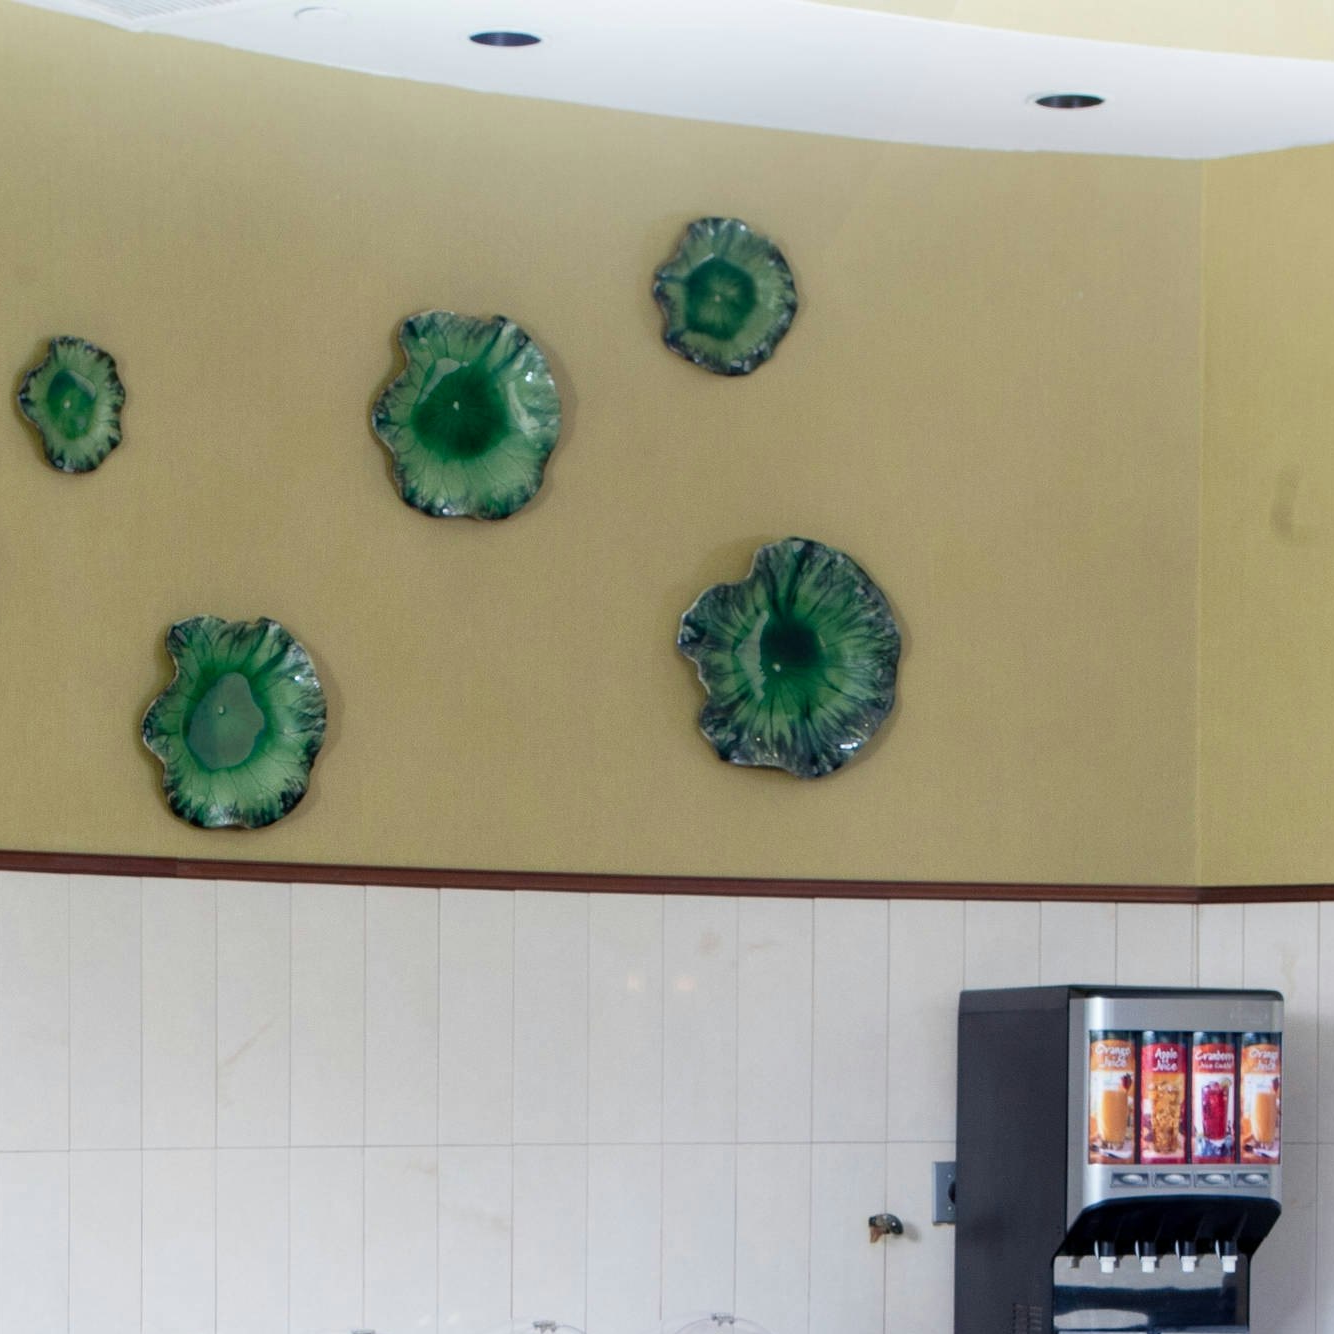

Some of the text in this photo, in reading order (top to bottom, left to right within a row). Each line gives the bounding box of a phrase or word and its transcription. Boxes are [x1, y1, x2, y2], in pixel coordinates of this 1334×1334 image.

[1095, 1043, 1132, 1060] Orange
[1154, 1047, 1178, 1060] Apple
[1152, 1059, 1178, 1072] Juice
